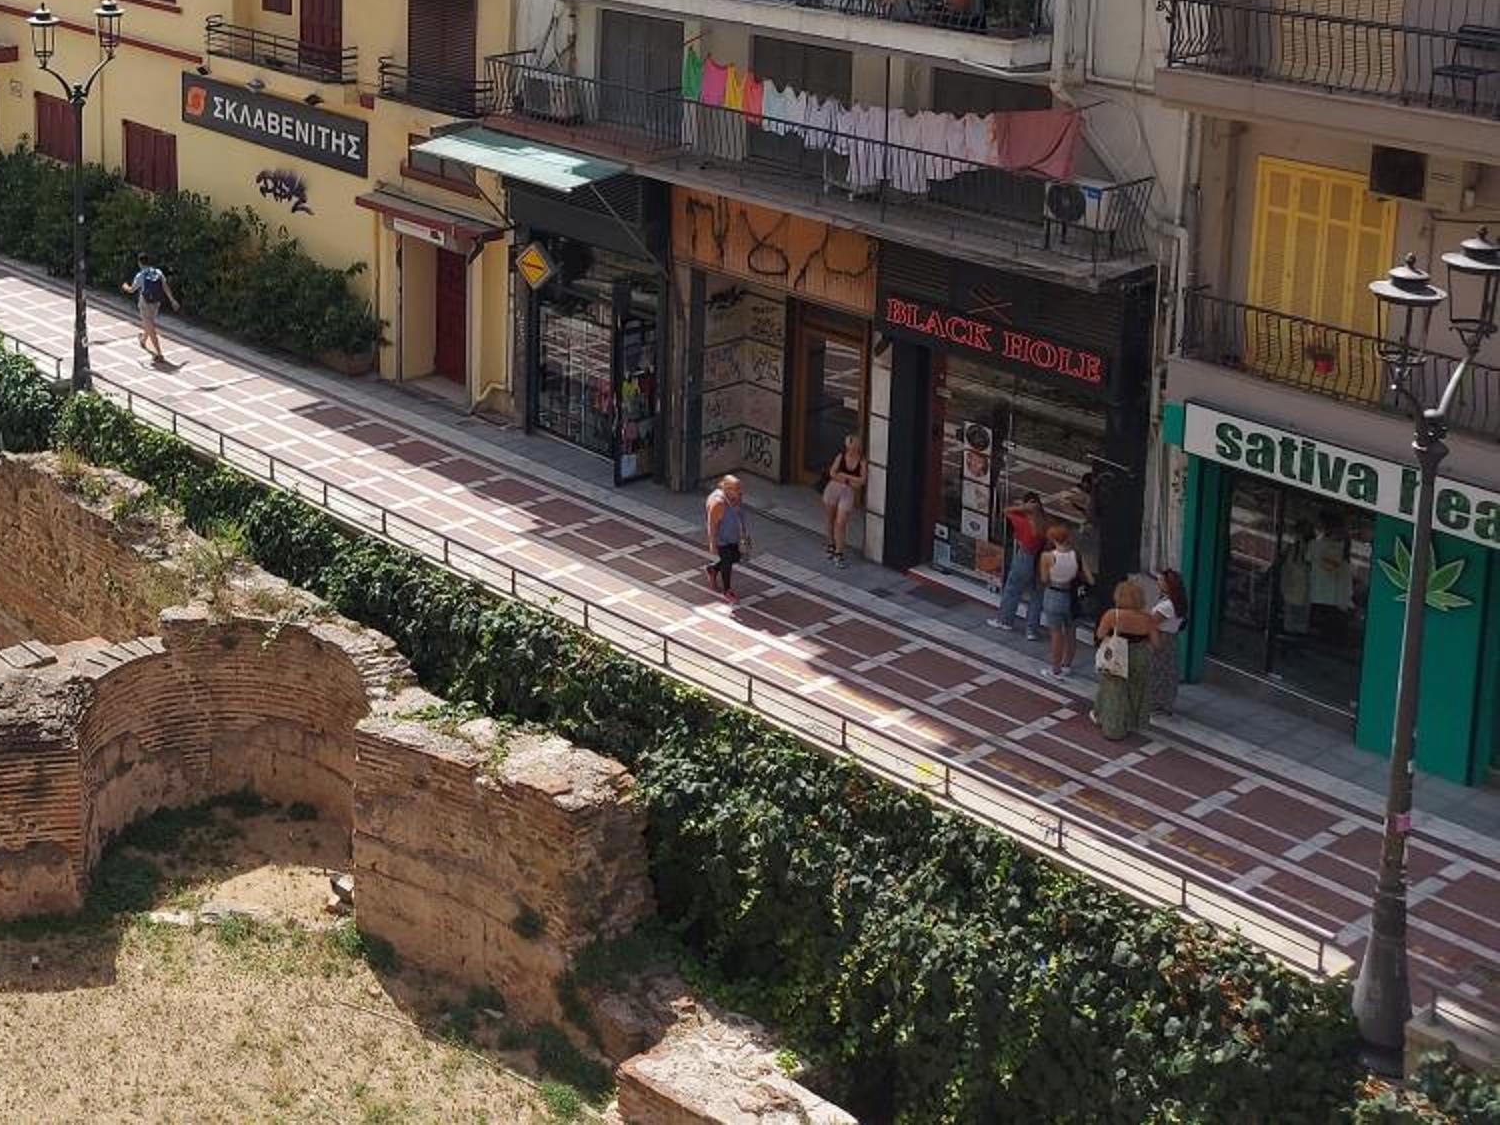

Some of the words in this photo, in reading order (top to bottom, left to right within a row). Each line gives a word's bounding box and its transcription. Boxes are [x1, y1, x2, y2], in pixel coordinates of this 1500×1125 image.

[212, 95, 361, 160] ΣΚΛΑΒΕΝΙΤΗΣ
[886, 298, 993, 352] BLACK
[1002, 330, 1101, 381] HOLE
[1214, 422, 1378, 506] sativa
